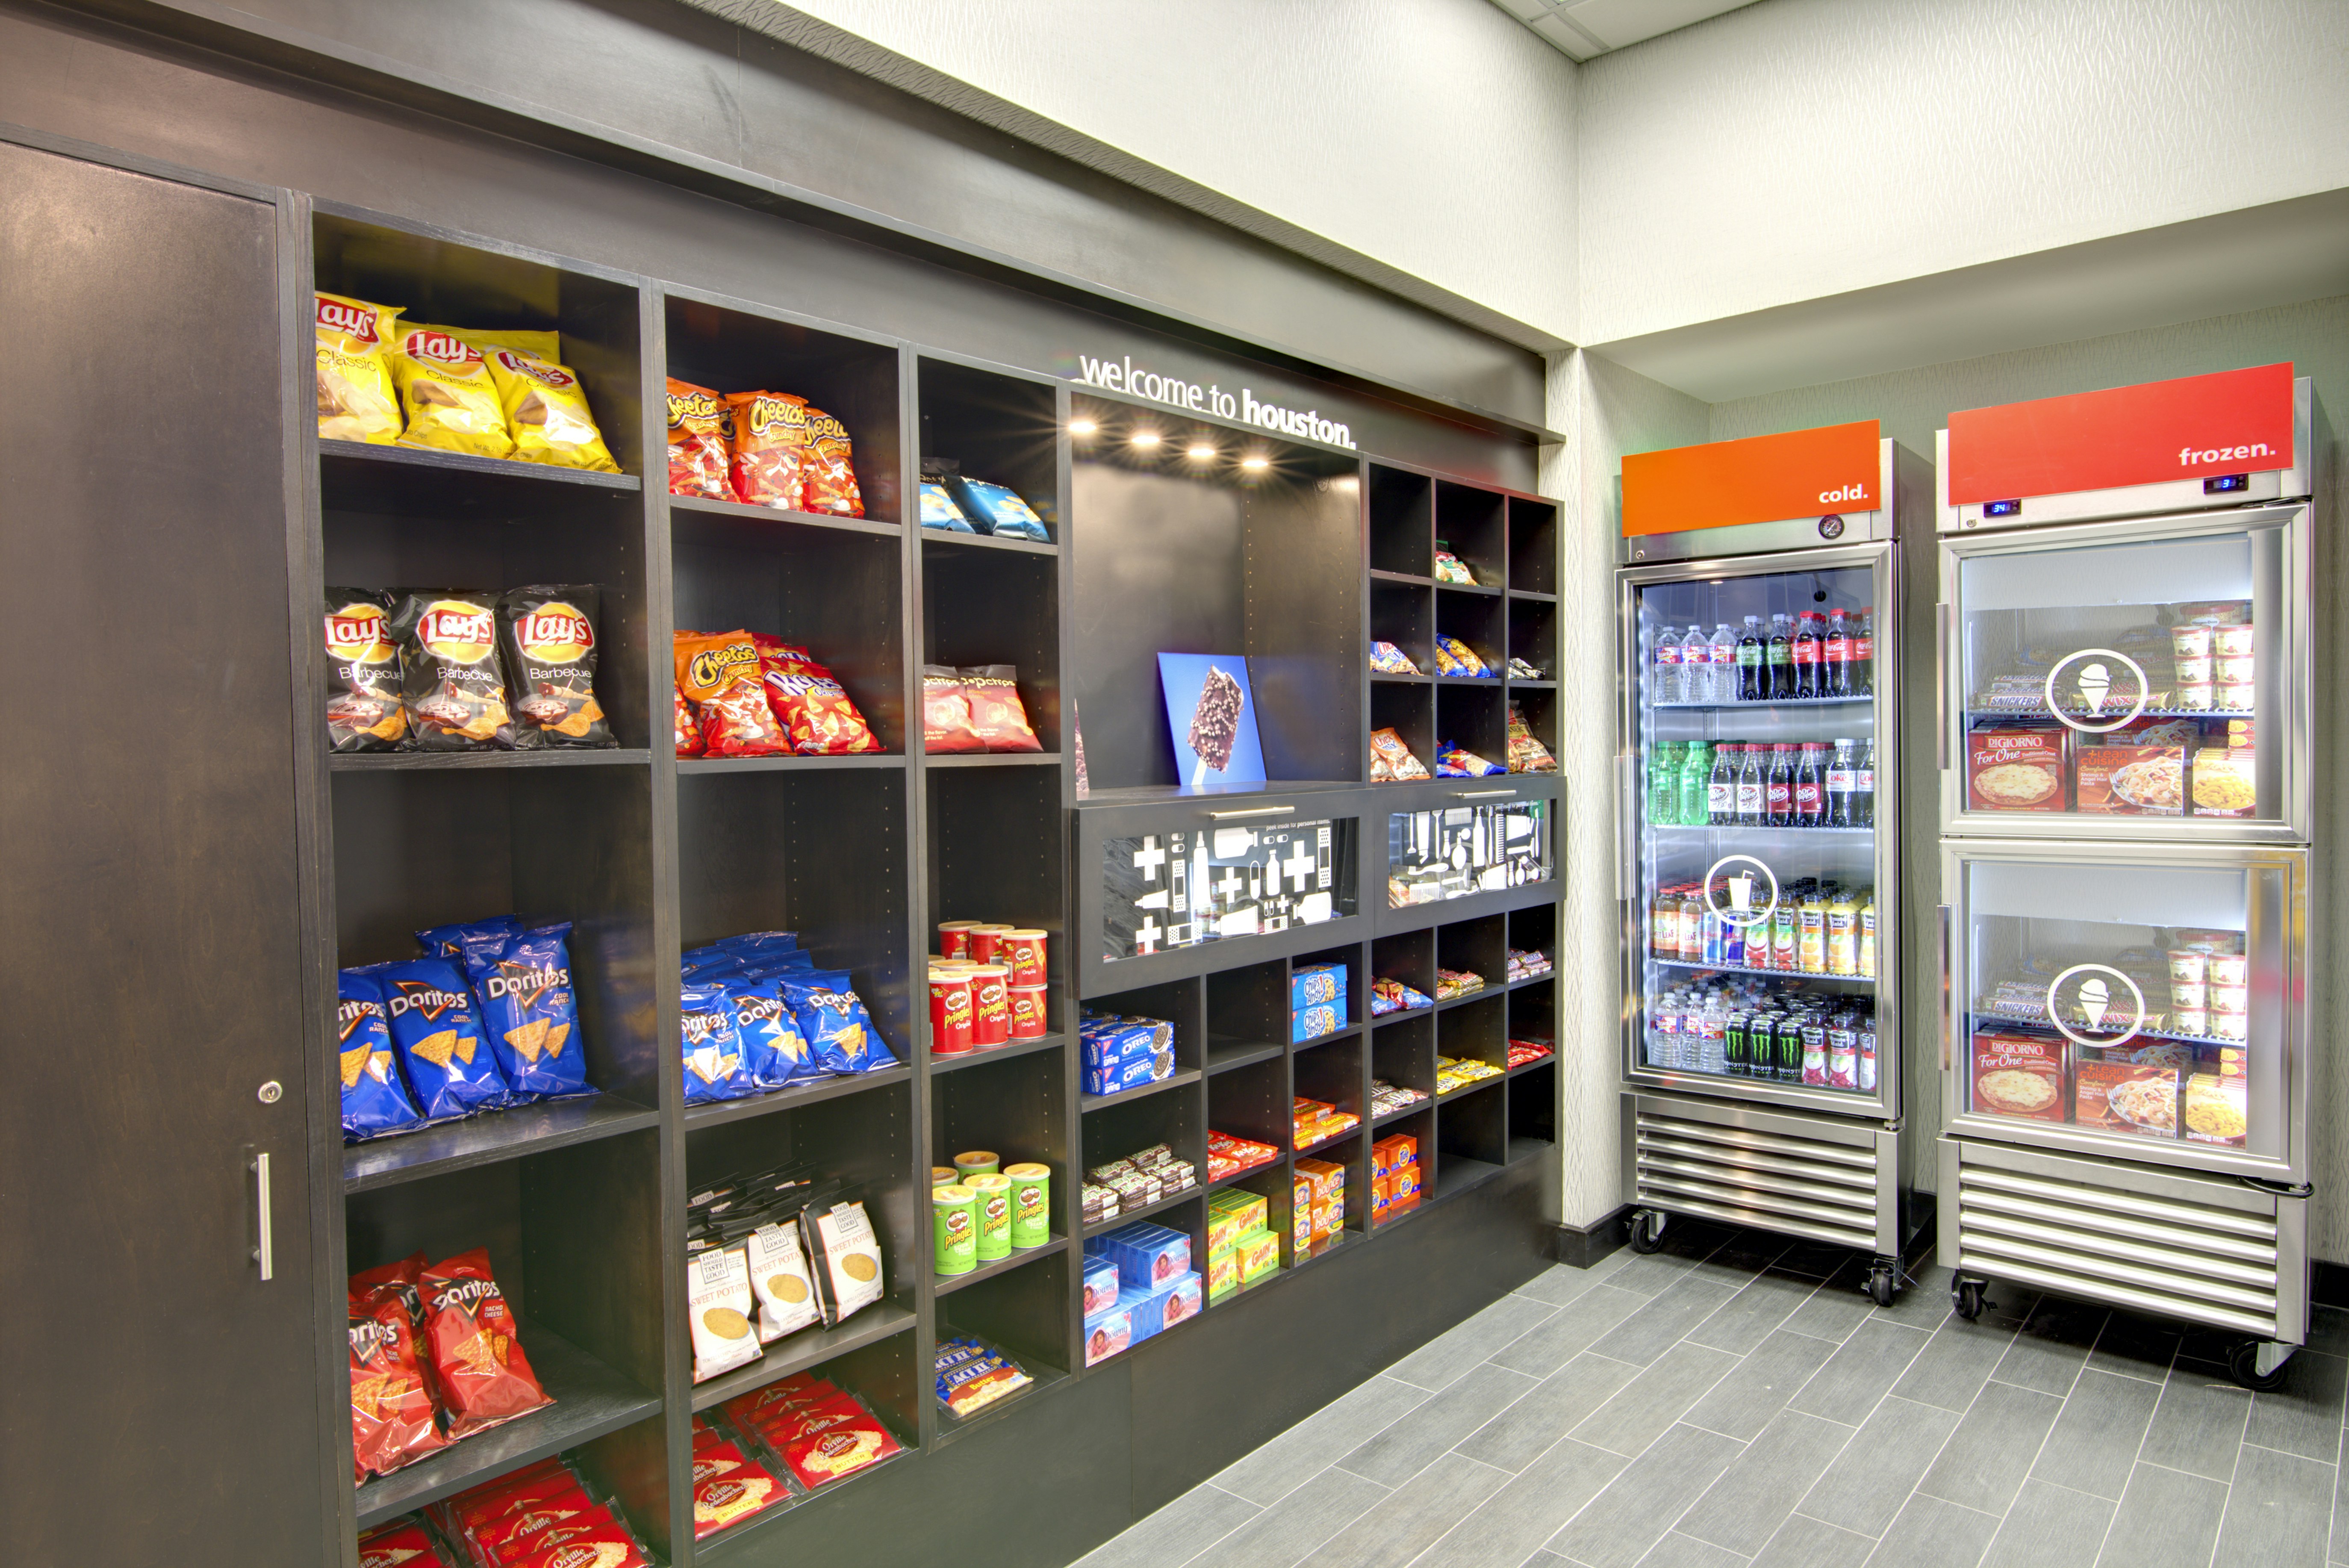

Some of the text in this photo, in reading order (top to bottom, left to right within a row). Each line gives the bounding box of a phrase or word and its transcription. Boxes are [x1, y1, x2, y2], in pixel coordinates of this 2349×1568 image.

[316, 349, 376, 371] Classic
[427, 370, 484, 389] Classic
[1079, 355, 1203, 411] welcome
[1209, 385, 1236, 419] to
[750, 398, 805, 433] Cheetos
[769, 429, 796, 442] Crunchy
[2178, 442, 2276, 466] frozen.
[1818, 483, 1868, 504] cold.
[1993, 504, 2006, 513] 34
[326, 615, 392, 647] Lay's
[427, 615, 493, 643] Lay's
[523, 614, 587, 647] Lay's
[437, 667, 493, 682] Barbecue
[530, 667, 592, 679] Barbecue
[692, 645, 758, 687] Cheetos
[722, 665, 753, 684] Crunchy
[1990, 696, 2040, 706] SNICKERS
[1373, 732, 1392, 747] Chex
[1974, 748, 2020, 765] For One
[1827, 772, 1847, 782] Coke
[1297, 819, 1317, 828] personal
[1014, 958, 1035, 972] Pringles
[487, 968, 569, 999] Doritos
[1305, 978, 1320, 996] Chips
[339, 1001, 384, 1021] ritos
[389, 990, 468, 1017] Doritos
[979, 999, 1005, 1022] Pringles
[1995, 1001, 2042, 1015] SNICKERS
[944, 1006, 971, 1029] Pringles
[1014, 1011, 1035, 1025] Pringles
[1305, 1011, 1320, 1029] Chips
[1122, 1035, 1151, 1056] OREO
[1978, 1053, 2022, 1068] For One
[1123, 1062, 1152, 1082] OREO
[2079, 1079, 2106, 1087] Comfort
[1400, 1151, 1411, 1164] Tide
[1317, 1176, 1340, 1198] bounce
[1401, 1181, 1412, 1195] Tide
[694, 1193, 713, 1204] FOOD
[833, 1203, 849, 1214] FOOD
[1017, 1202, 1044, 1223] Pringles
[838, 1214, 852, 1223] TASTE
[840, 1219, 855, 1229] GOOD
[984, 1211, 1009, 1236] Pringles
[1315, 1209, 1339, 1231] bounce
[758, 1225, 777, 1234] FOOD
[764, 1232, 783, 1243] TASTE
[766, 1238, 785, 1250] GOOD
[828, 1239, 852, 1255] SWEET
[944, 1226, 973, 1251] Pringles
[702, 1251, 722, 1262] FOOD
[704, 1262, 724, 1273] TASTE
[705, 1269, 725, 1281] GOOD
[752, 1259, 778, 1276] SWEET
[691, 1282, 748, 1307] SWEET POTATO
[952, 1362, 990, 1384] ACT II
[968, 1375, 996, 1391] Butter
[817, 1435, 861, 1460] Redenbacher's
[822, 1432, 849, 1451] Orville
[835, 1453, 866, 1469] BUTTER
[701, 1483, 749, 1510] Redenbacher's
[706, 1484, 733, 1501] Orville
[721, 1500, 754, 1518] BUTTER
